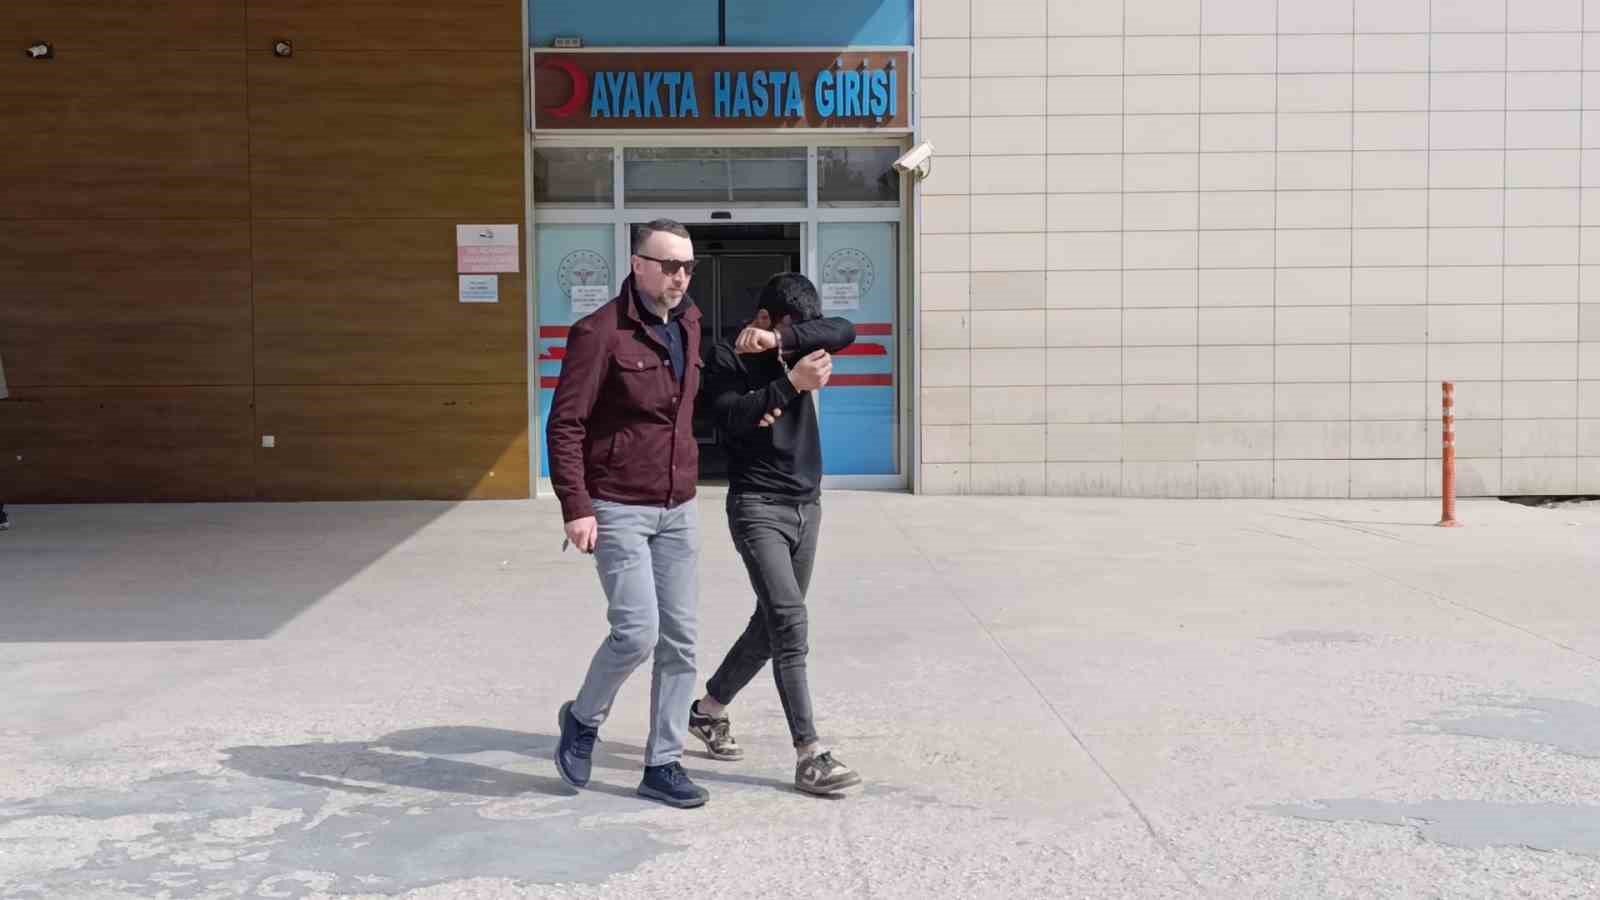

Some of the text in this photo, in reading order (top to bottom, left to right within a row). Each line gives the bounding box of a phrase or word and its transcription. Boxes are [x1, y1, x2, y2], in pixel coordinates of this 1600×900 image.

[591, 57, 897, 122] AYAKTA HASTA GİRİŞİ
